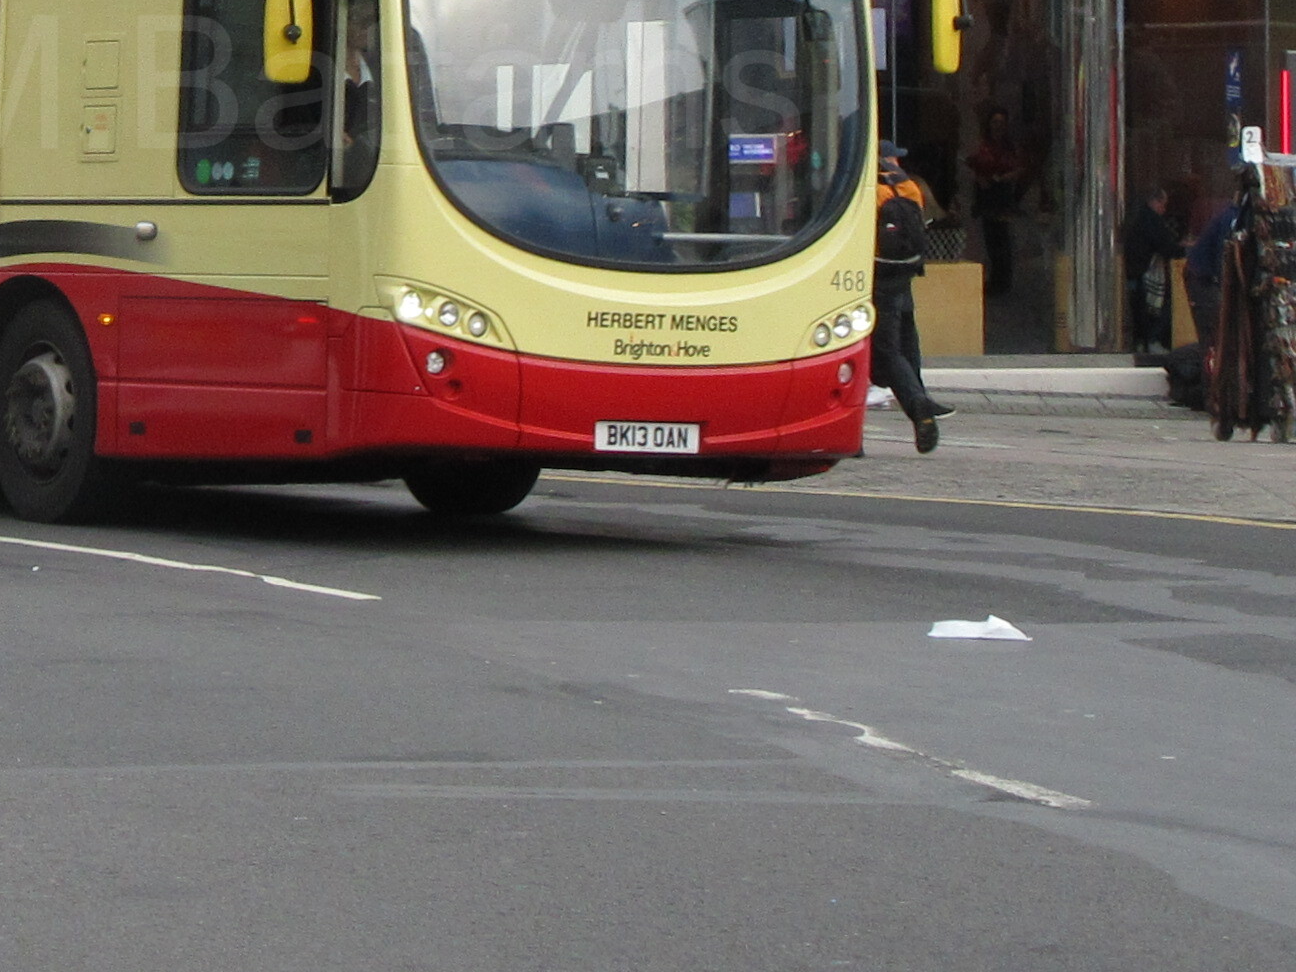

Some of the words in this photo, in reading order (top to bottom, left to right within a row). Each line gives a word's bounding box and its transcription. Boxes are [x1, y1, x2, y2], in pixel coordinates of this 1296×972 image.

[830, 270, 865, 292] 468
[587, 311, 666, 331] HERBERT
[670, 314, 738, 333] MENGES
[607, 424, 647, 447] BK13
[653, 427, 688, 449] OAN
